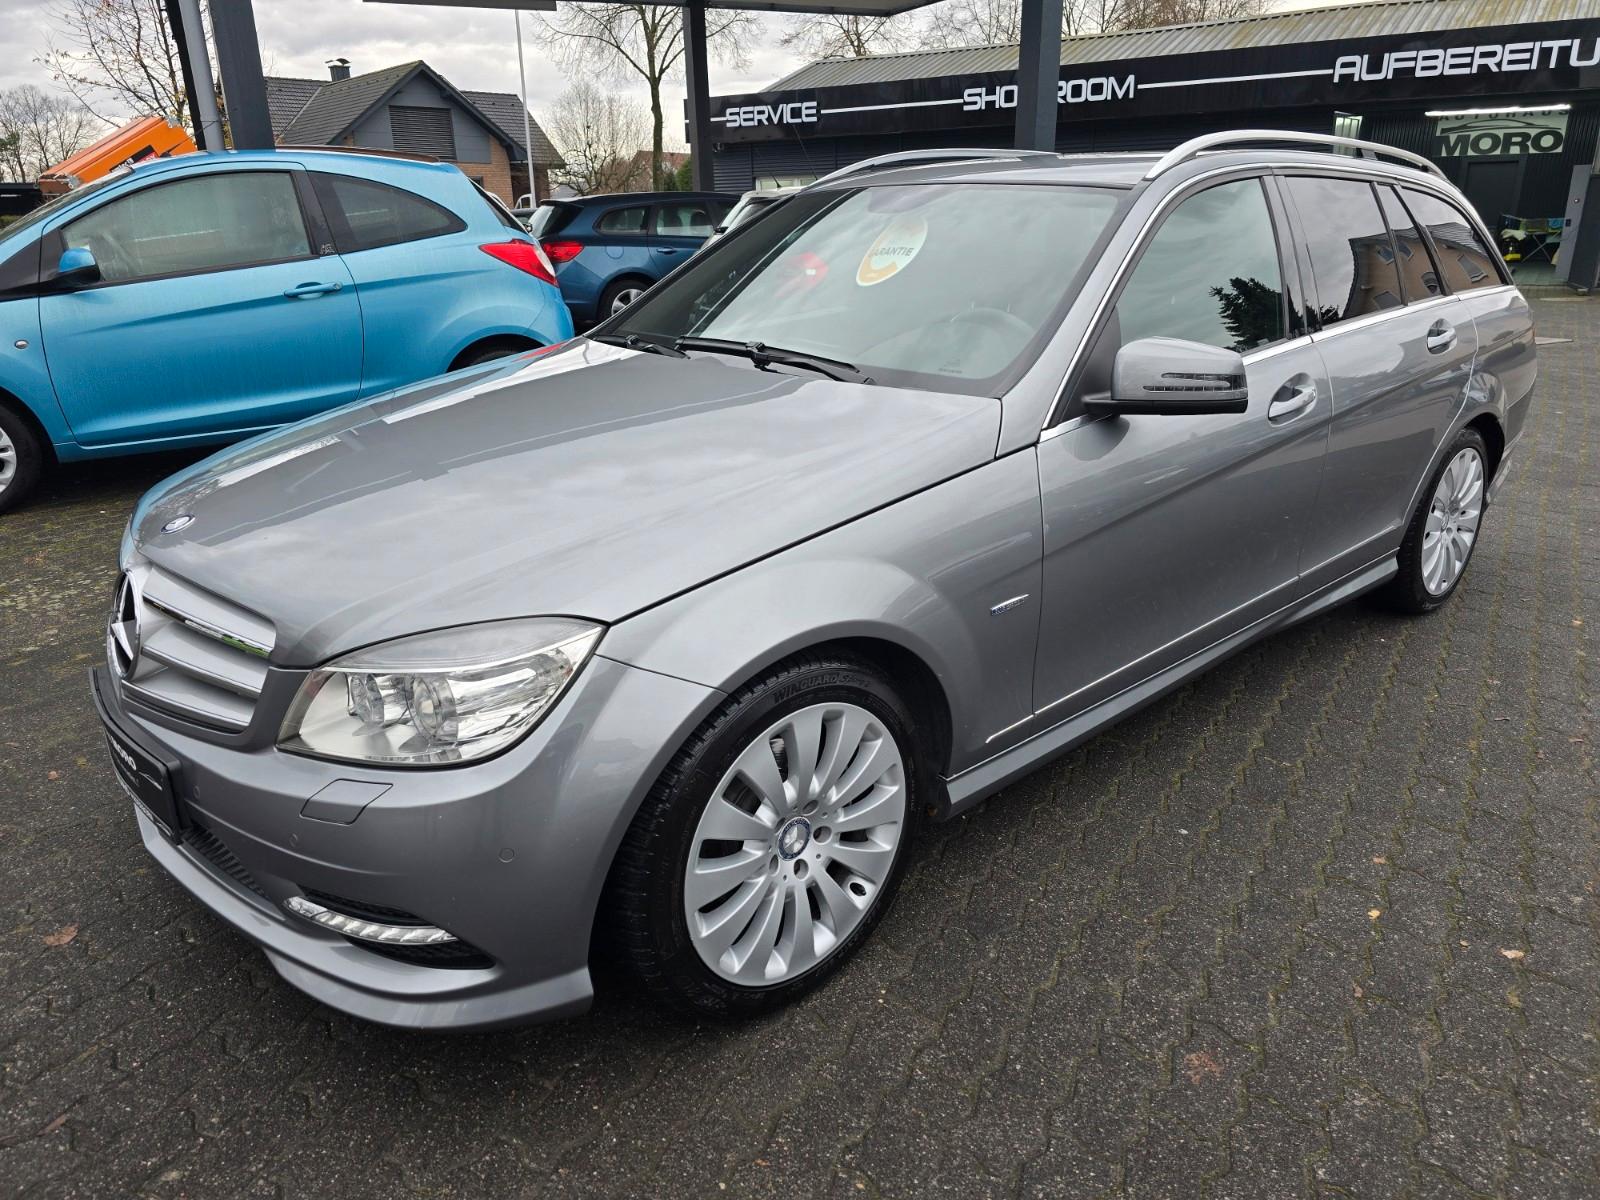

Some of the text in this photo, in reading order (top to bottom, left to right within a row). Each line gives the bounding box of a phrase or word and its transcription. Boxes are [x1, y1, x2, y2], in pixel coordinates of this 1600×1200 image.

[1333, 37, 1600, 83] AUFBEREITU
[963, 74, 1136, 111] SHOOOM
[726, 101, 818, 128] SERVICE
[1435, 130, 1564, 156] MORO
